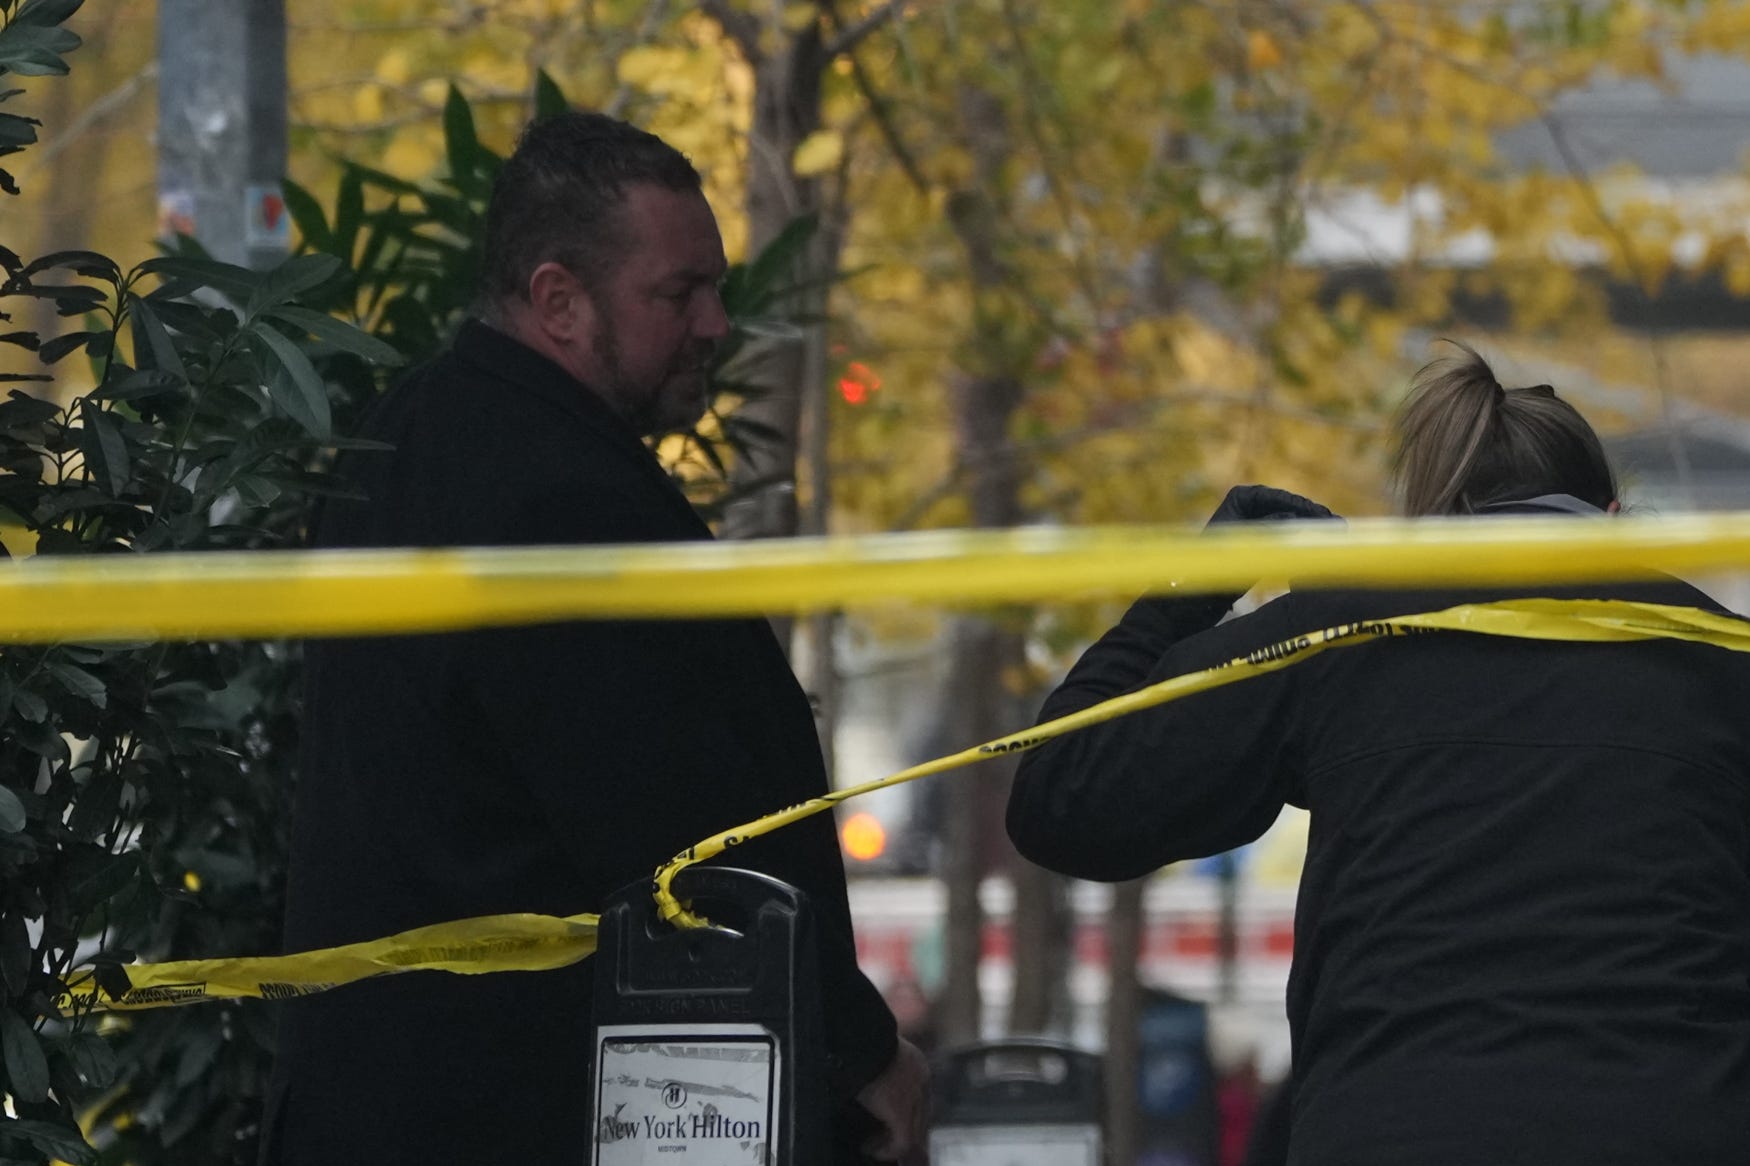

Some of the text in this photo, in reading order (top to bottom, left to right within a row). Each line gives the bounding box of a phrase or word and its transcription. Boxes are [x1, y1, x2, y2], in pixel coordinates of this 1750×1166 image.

[605, 1113, 761, 1140] New York Hilton
